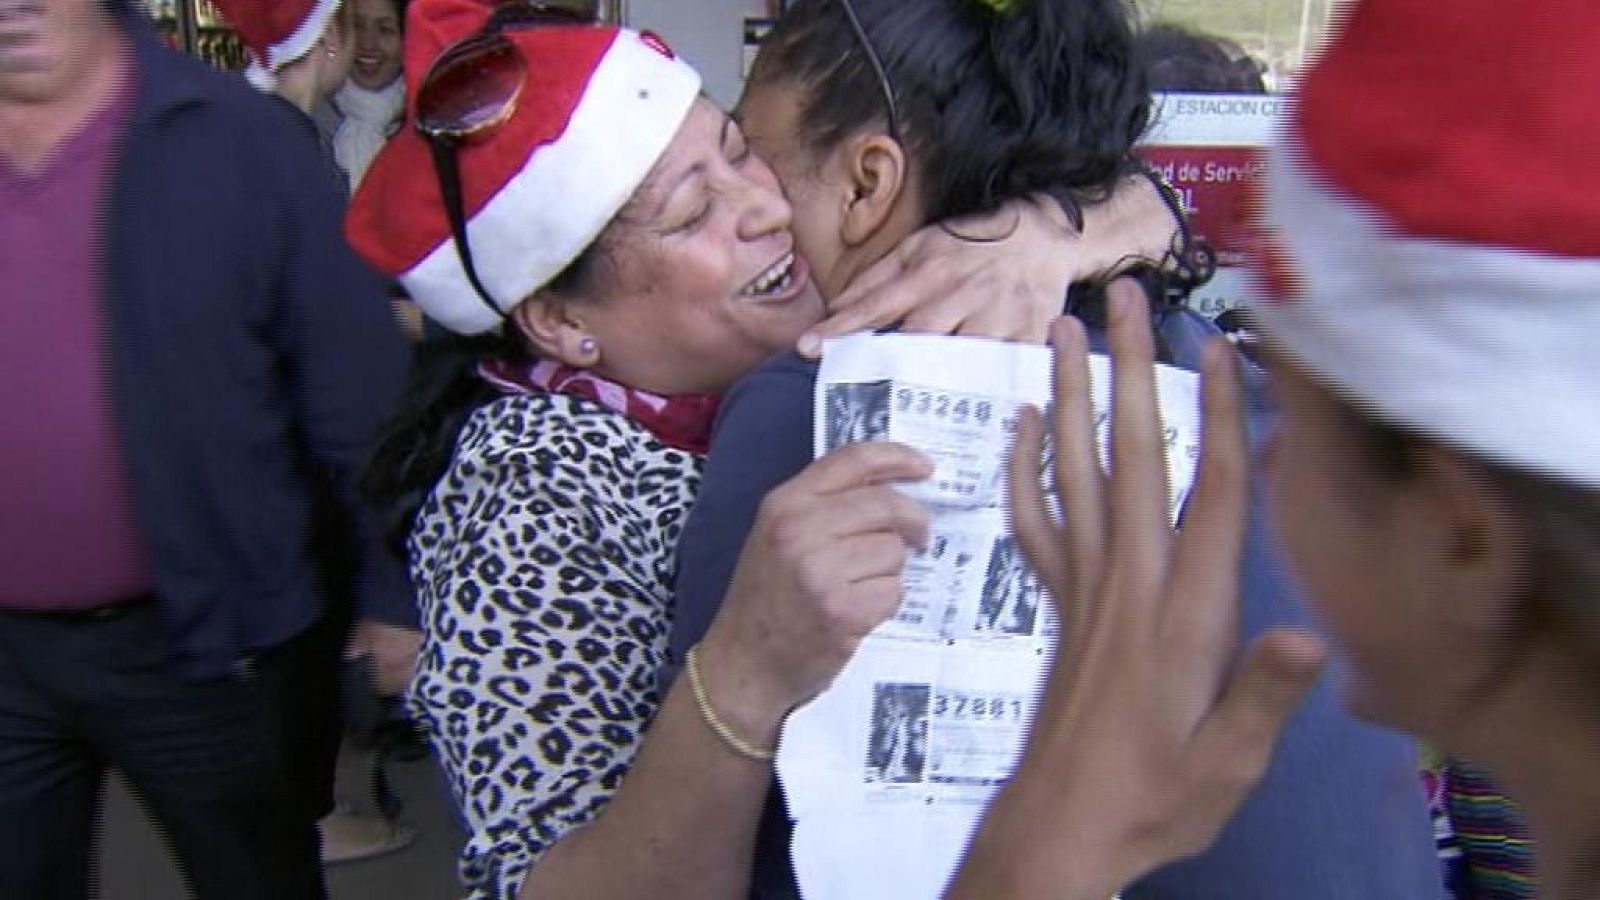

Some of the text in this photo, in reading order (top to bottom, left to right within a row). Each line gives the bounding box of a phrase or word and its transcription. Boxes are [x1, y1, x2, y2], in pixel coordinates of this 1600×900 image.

[1175, 99, 1257, 116] ESTACION
[1178, 161, 1201, 182] de
[896, 387, 993, 424] 93248
[932, 693, 1022, 716] 37881
